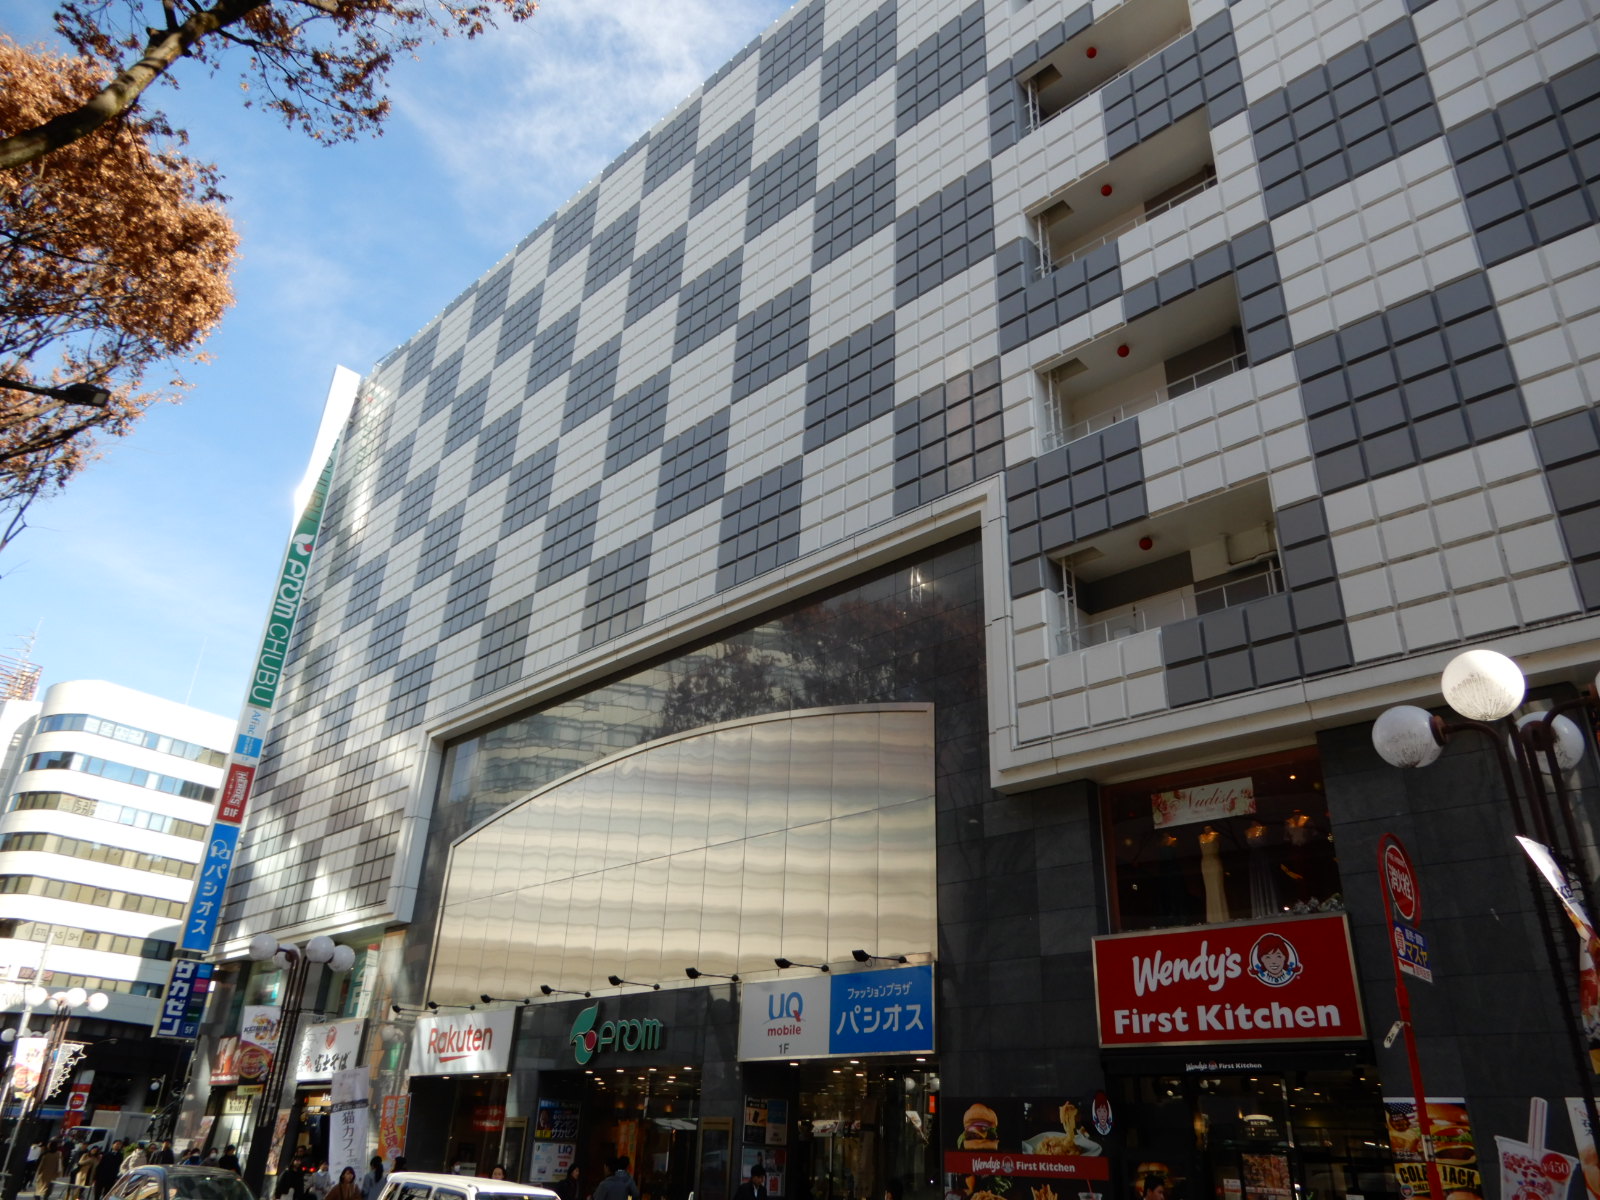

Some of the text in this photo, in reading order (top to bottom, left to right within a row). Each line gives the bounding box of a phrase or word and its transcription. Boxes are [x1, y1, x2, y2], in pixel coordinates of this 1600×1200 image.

[252, 623, 289, 703] CHUBU
[1388, 863, 1413, 901] 消火栓
[192, 864, 227, 935] パシオス
[1132, 940, 1242, 997] Wendy's
[1404, 941, 1429, 968] マスヤ
[158, 961, 196, 1036] サカゼン
[768, 991, 804, 1022] UQ
[847, 982, 913, 1000] ファッションプラザ
[767, 1025, 801, 1037] mobile
[836, 1004, 925, 1036] パシオス
[1113, 1001, 1341, 1035] First Kitchen
[427, 1024, 493, 1054] Rakuten
[779, 1043, 790, 1055] 1F
[1218, 1062, 1233, 1070] First
[1235, 1062, 1263, 1070] Kitchen
[342, 1110, 356, 1157] 猫カフェ
[972, 1156, 1076, 1173] Wendy's First Kitchen
